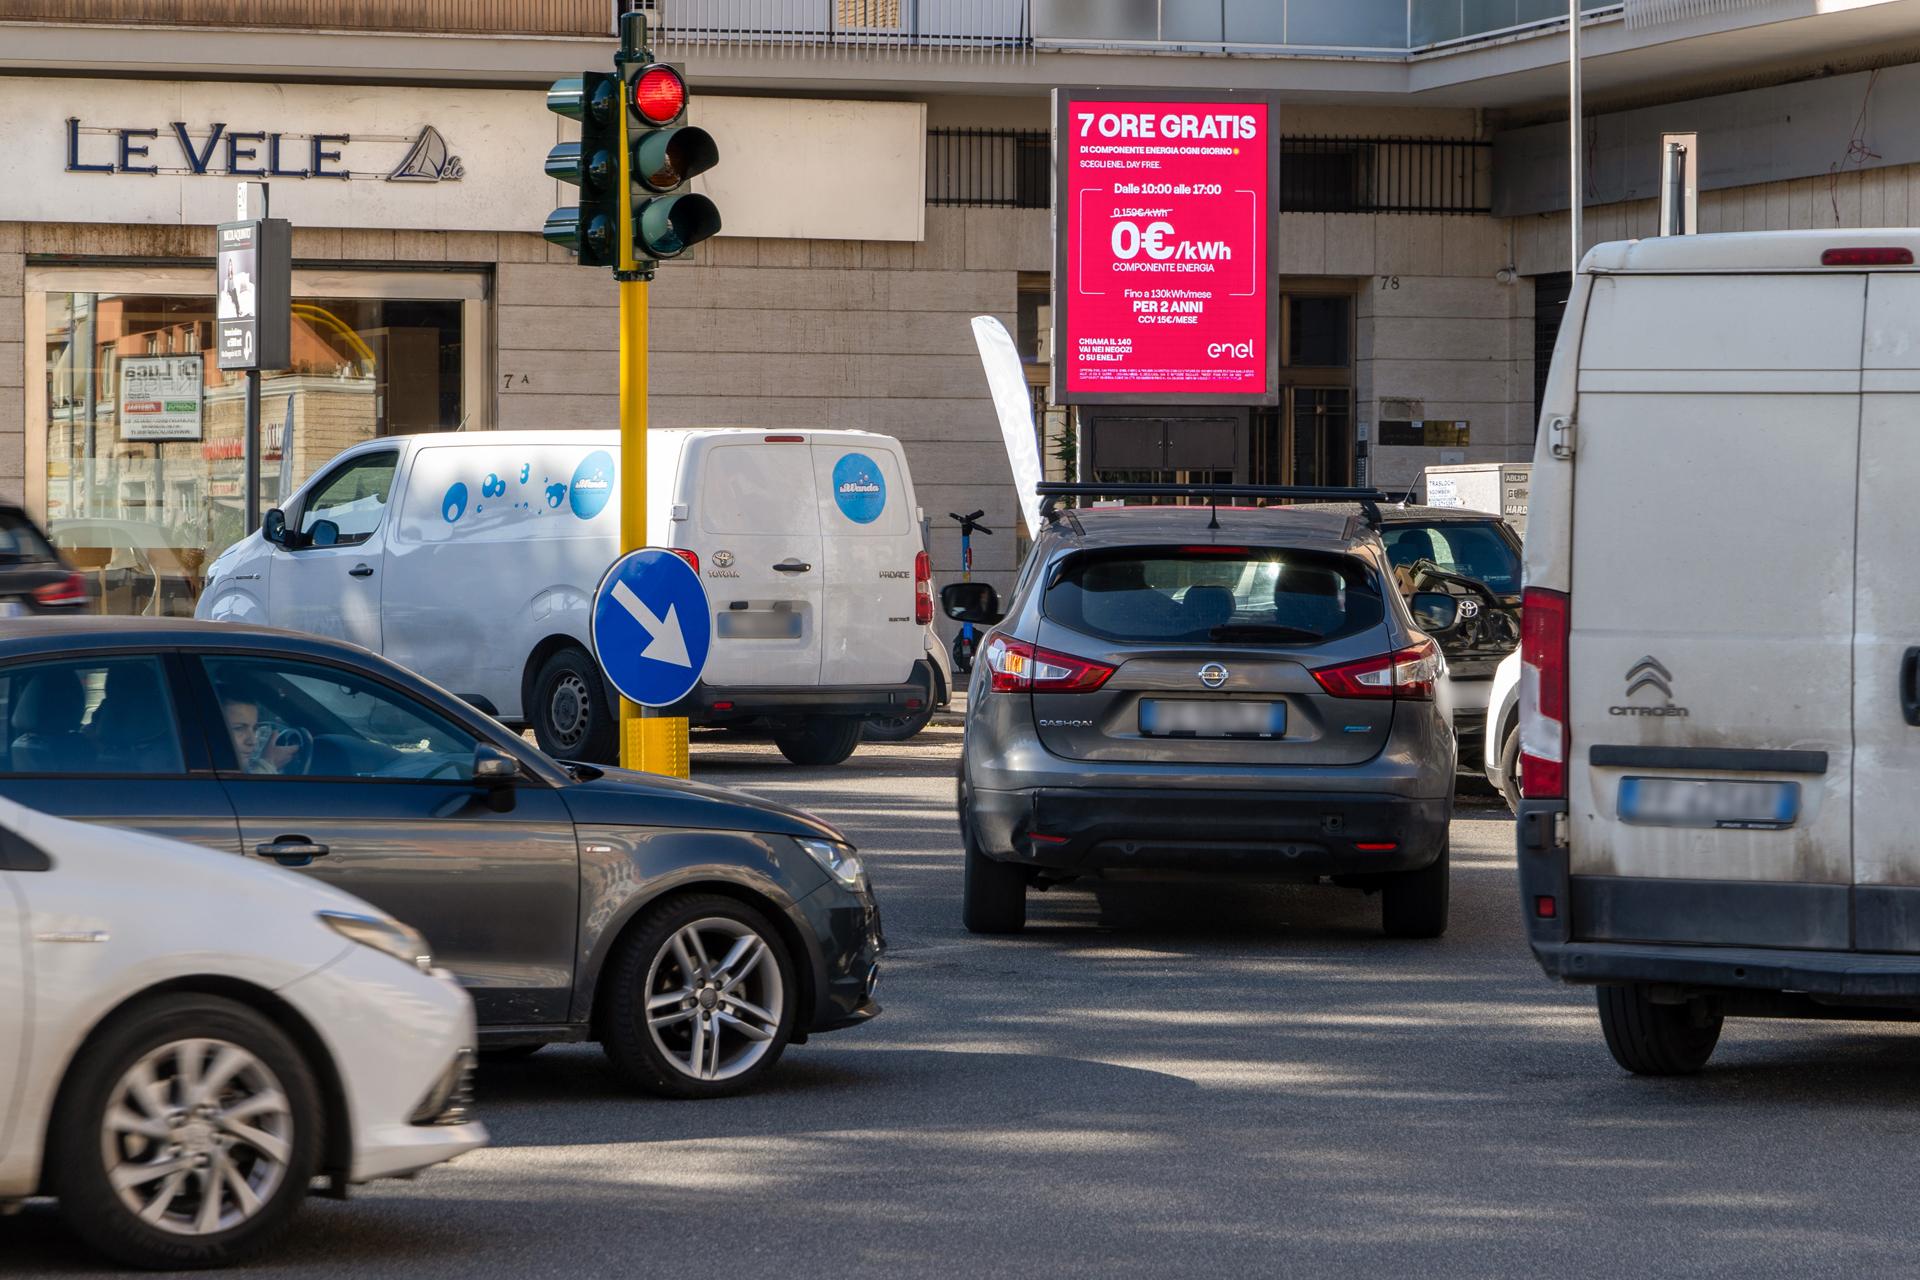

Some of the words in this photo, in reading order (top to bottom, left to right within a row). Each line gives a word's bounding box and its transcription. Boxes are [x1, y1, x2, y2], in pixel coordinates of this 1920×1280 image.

[1077, 113, 1095, 137] 7
[1098, 113, 1156, 138] ORE
[1160, 114, 1257, 139] GRATIS
[169, 121, 350, 180] VELE
[1080, 145, 1089, 154] DI
[1089, 145, 1144, 155] COMPONENTE
[1145, 146, 1179, 155] ENERGIA
[1179, 146, 1200, 155] OGNI
[1201, 147, 1233, 156] GIORNO
[1079, 160, 1106, 168] SCEGLI
[1107, 160, 1125, 168] ENEL
[1126, 160, 1141, 169] DAY
[1114, 183, 1140, 194] Dalle
[1141, 183, 1172, 195] 10:00
[1173, 184, 1192, 195] alle
[1192, 184, 1222, 195] 17:00
[1112, 262, 1175, 272] COMPONENTE
[1176, 263, 1215, 273] ENERGIA
[1380, 275, 1400, 290] 78
[1124, 288, 1143, 298] Fino
[1151, 289, 1212, 299] 130kWh/mese
[1133, 300, 1158, 313] PER
[1160, 300, 1169, 313] 2
[1170, 301, 1203, 313] ANNI
[1137, 315, 1156, 324] CCV
[1156, 315, 1198, 324] 15€/MESE
[1207, 338, 1254, 359] enel
[504, 374, 514, 389] 7
[521, 374, 529, 384] A
[707, 570, 740, 578] TOYOTA
[879, 570, 910, 578] PROACE
[1200, 671, 1228, 679] NISSAN
[1039, 718, 1093, 728] QASHQAI
